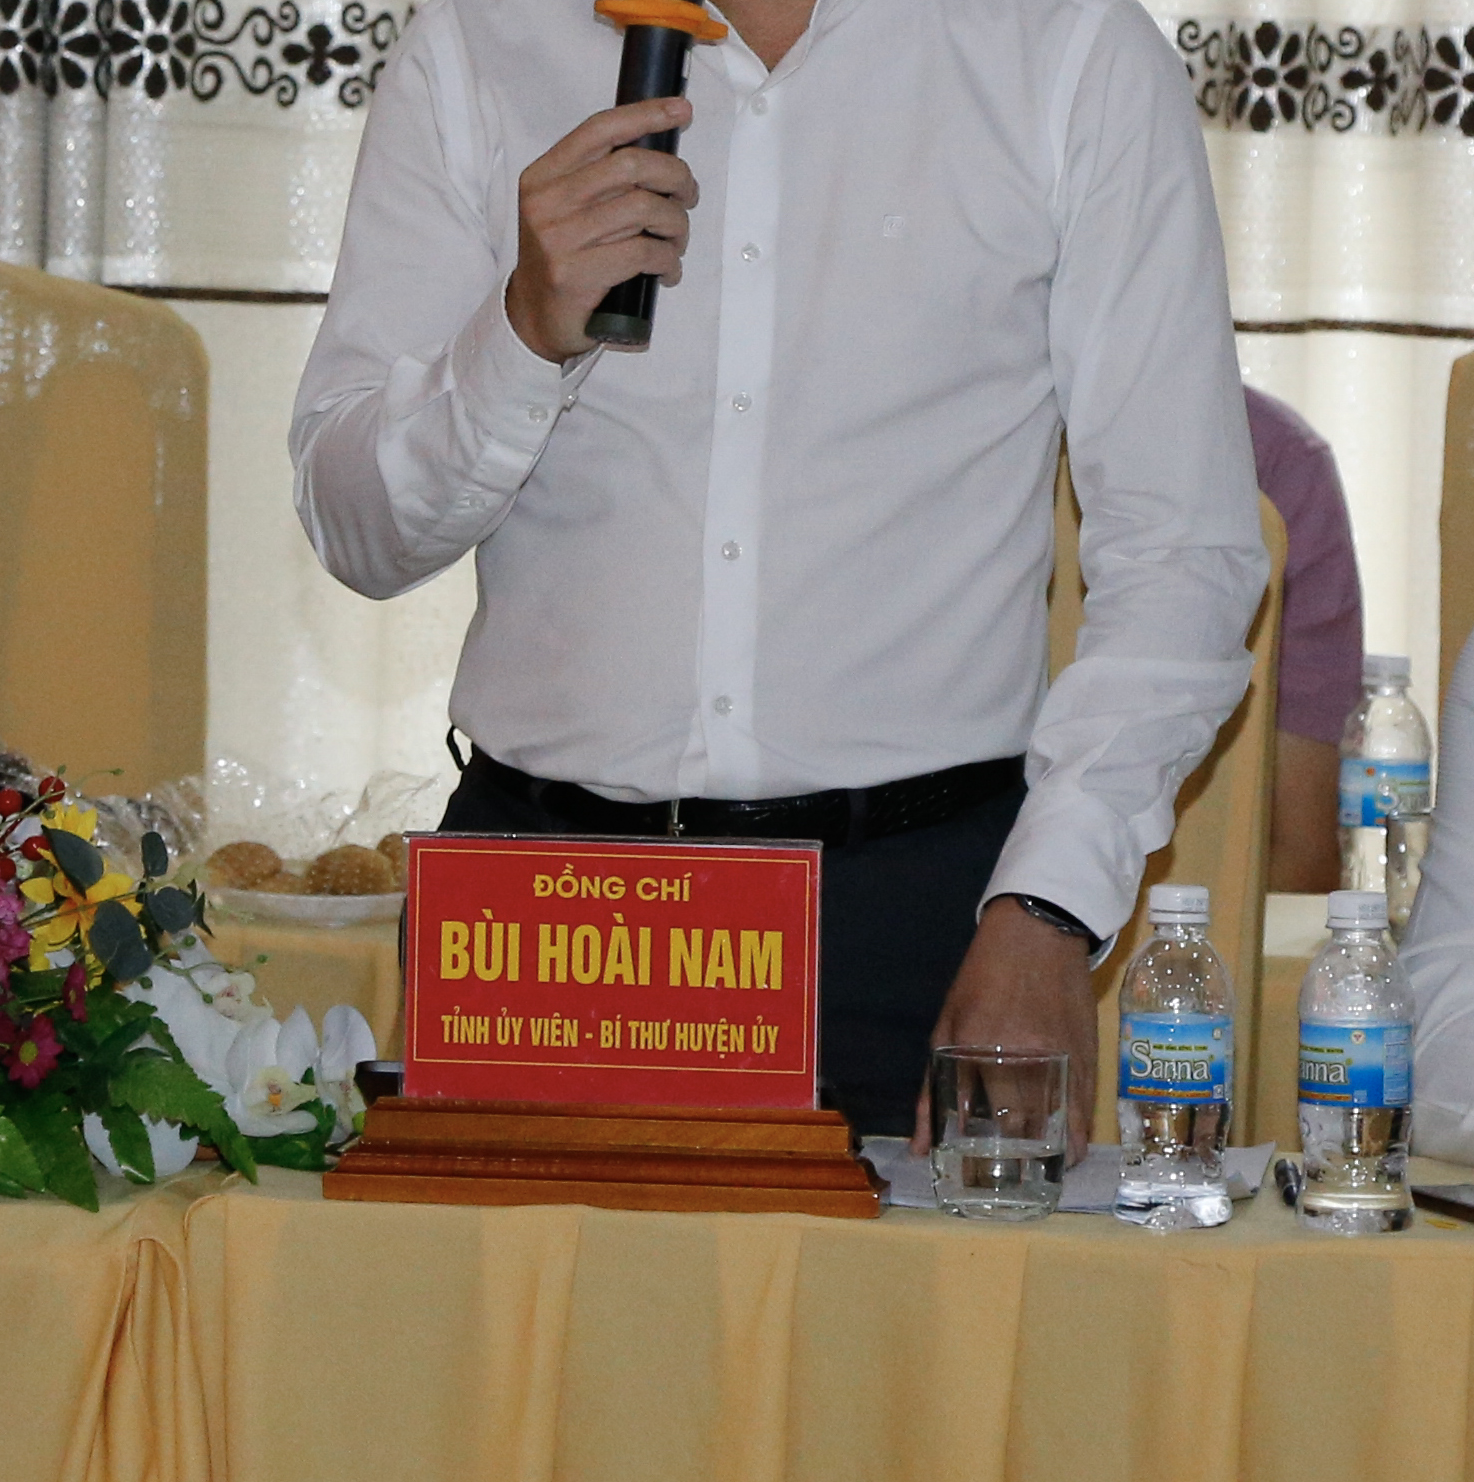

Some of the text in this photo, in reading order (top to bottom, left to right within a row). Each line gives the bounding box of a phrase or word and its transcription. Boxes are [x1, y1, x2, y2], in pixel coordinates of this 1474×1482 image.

[532, 862, 693, 902] ĐỒNG CHÍ
[439, 908, 783, 991] BÙI HOÀI NAM
[440, 1005, 491, 1045] TỈNH
[496, 1006, 524, 1046] ỦY
[529, 1012, 579, 1048] VIÊN
[599, 1013, 622, 1049] BÍ
[627, 1018, 671, 1051] THƯ
[674, 1017, 745, 1059] HUYỆN
[751, 1014, 780, 1054] ỦY
[1130, 1040, 1210, 1081] Sanna
[1299, 1061, 1346, 1084] anna
